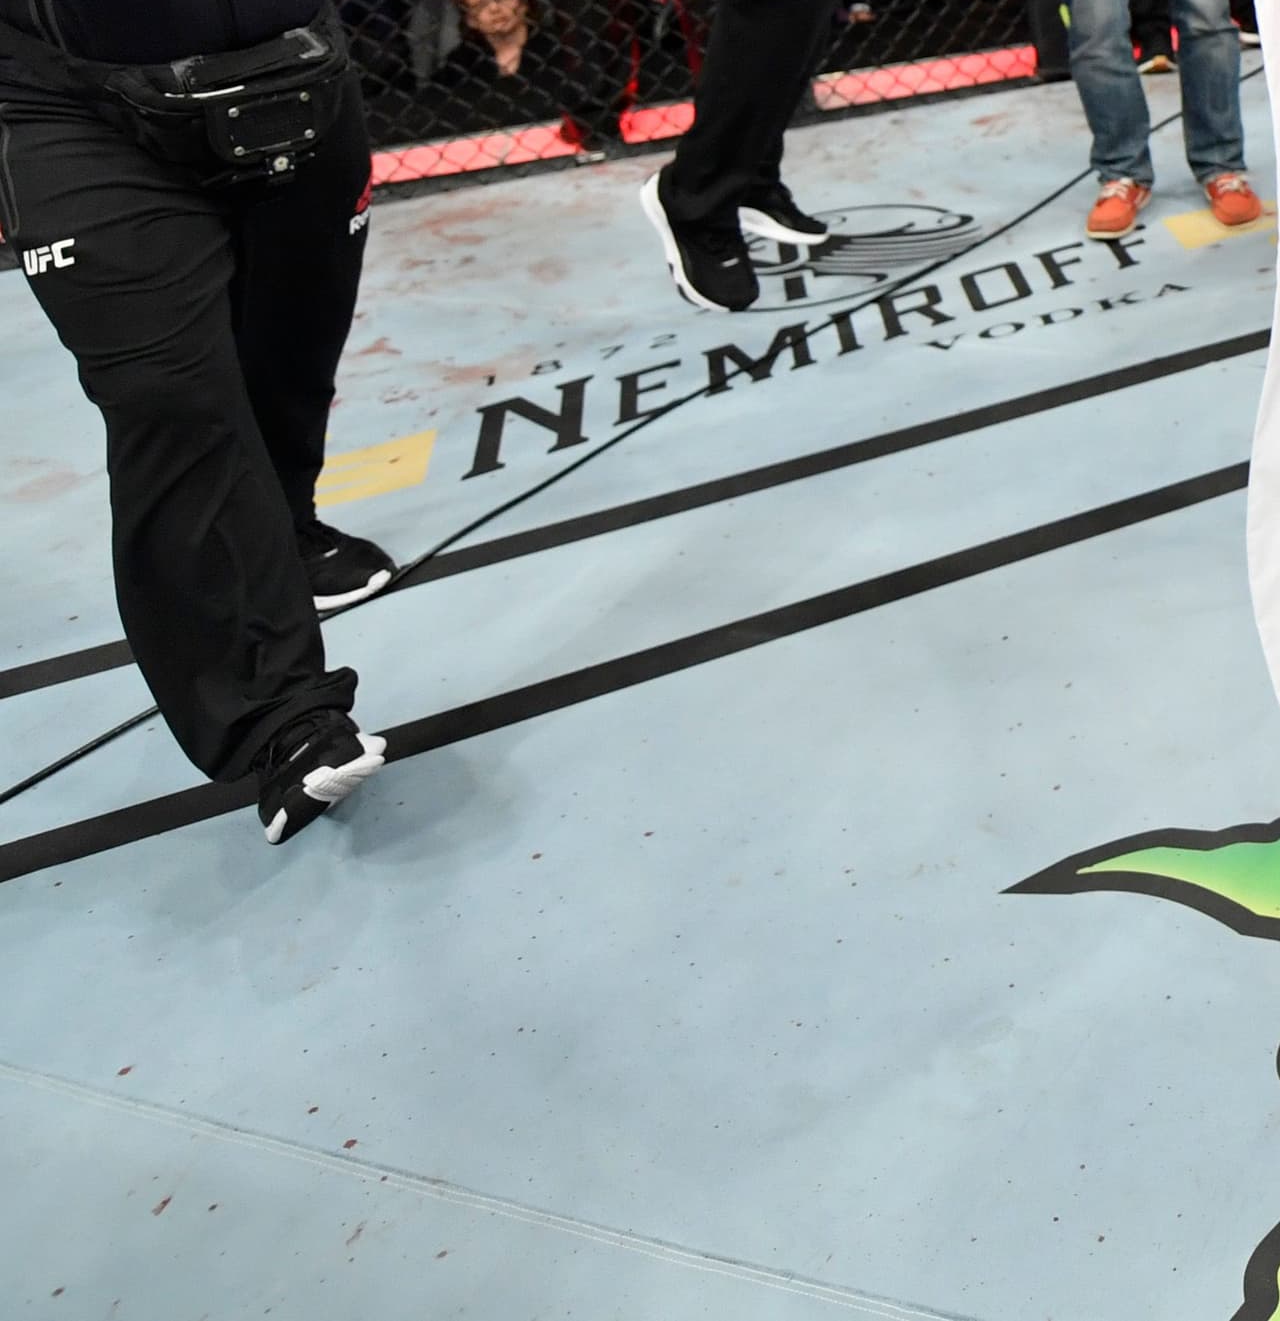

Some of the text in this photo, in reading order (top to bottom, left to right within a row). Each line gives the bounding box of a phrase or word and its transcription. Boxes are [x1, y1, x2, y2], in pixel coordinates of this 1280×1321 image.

[23, 238, 75, 276] UFC
[924, 283, 1193, 350] VODKA
[462, 225, 1146, 481] NEMIROFF
